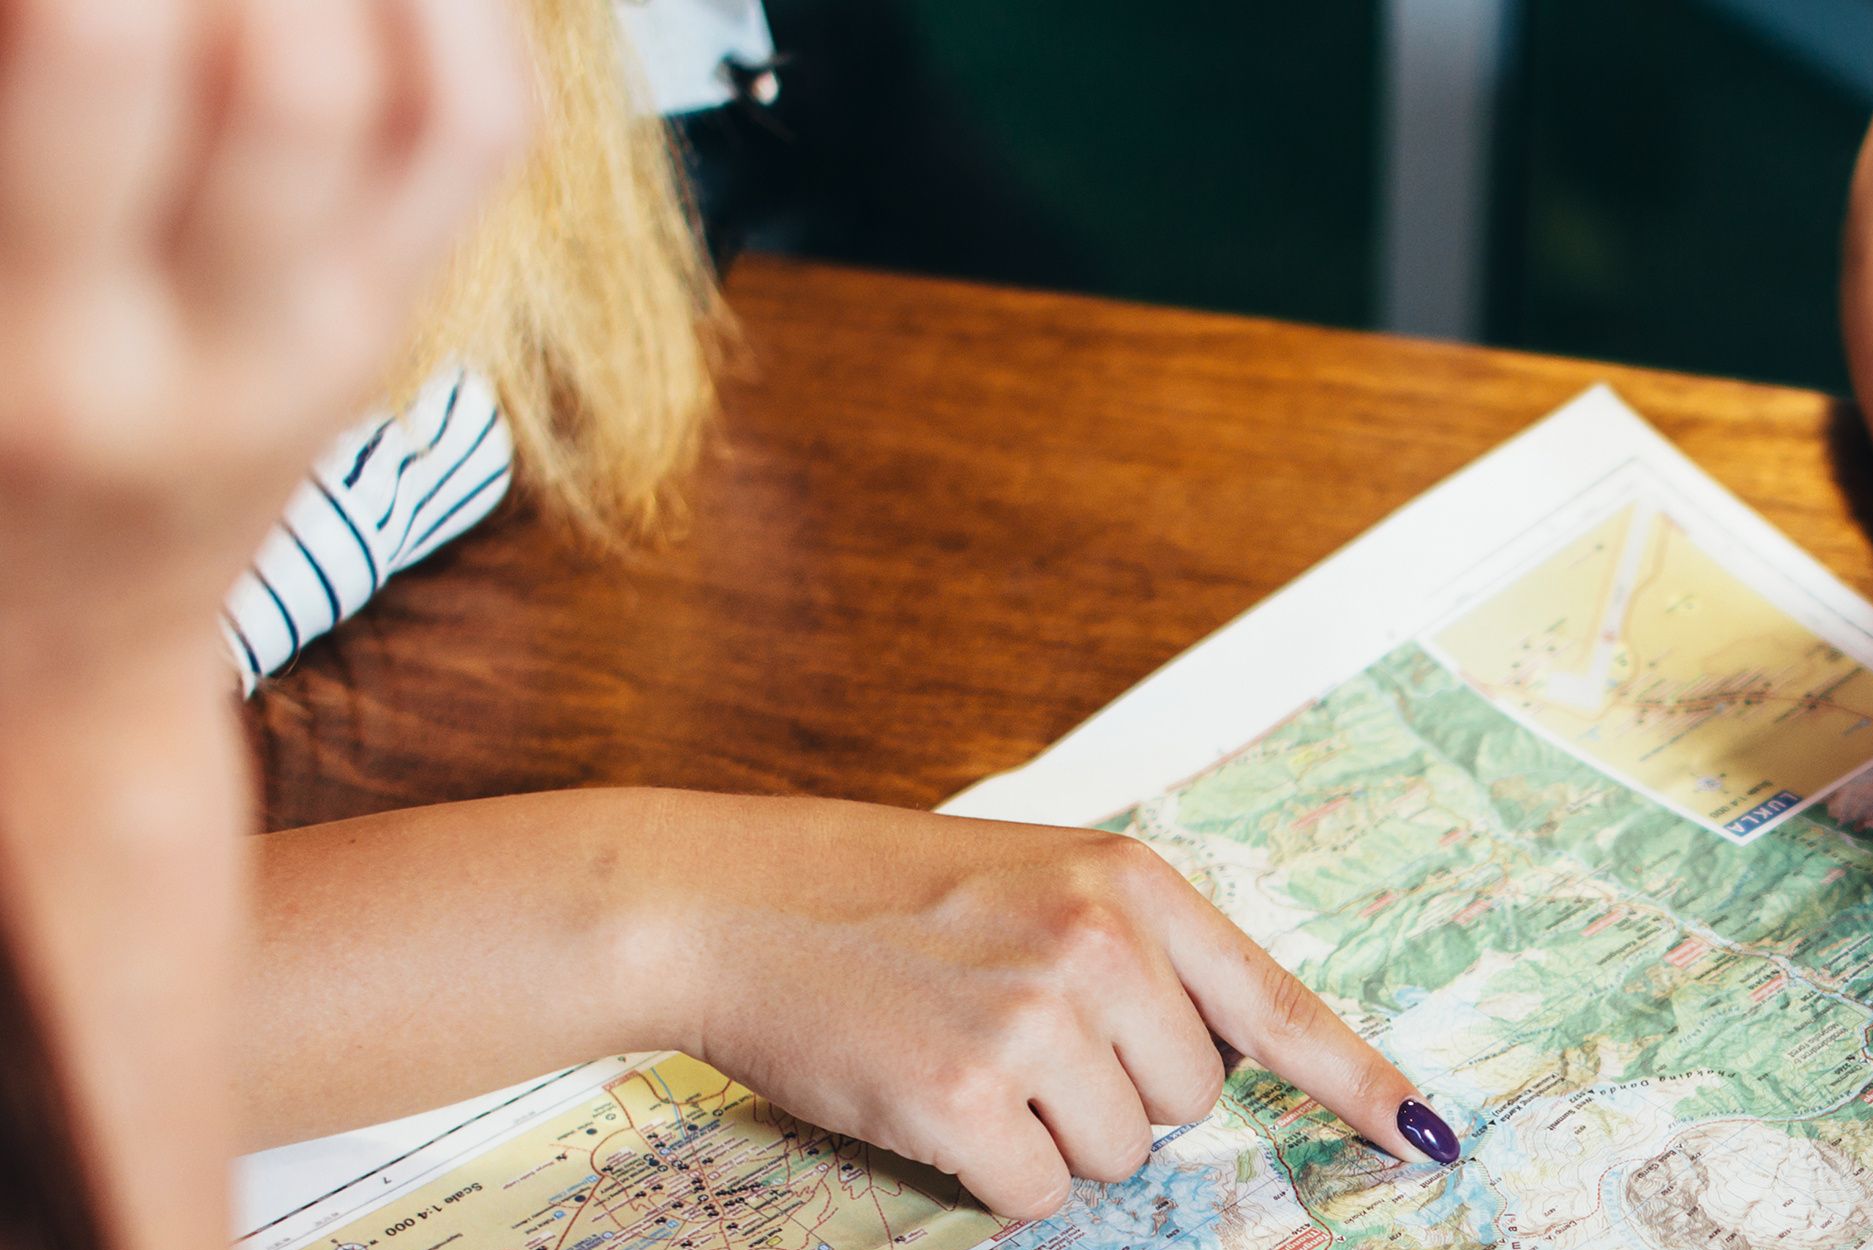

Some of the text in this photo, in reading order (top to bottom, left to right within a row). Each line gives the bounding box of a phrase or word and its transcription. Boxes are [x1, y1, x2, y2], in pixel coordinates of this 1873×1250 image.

[1725, 790, 1794, 836] LUKLA
[1787, 1020, 1839, 1058] Magnolia Forest
[1599, 1078, 1648, 1097] Danda
[1498, 1097, 1533, 1123] Karda
[1545, 1094, 1593, 1131] West Summit
[1149, 1136, 1168, 1151] TREK
[1419, 1168, 1447, 1189] Summit
[1635, 1148, 1676, 1180] Base Camp
[383, 1180, 481, 1238] Scale 1:4 000
